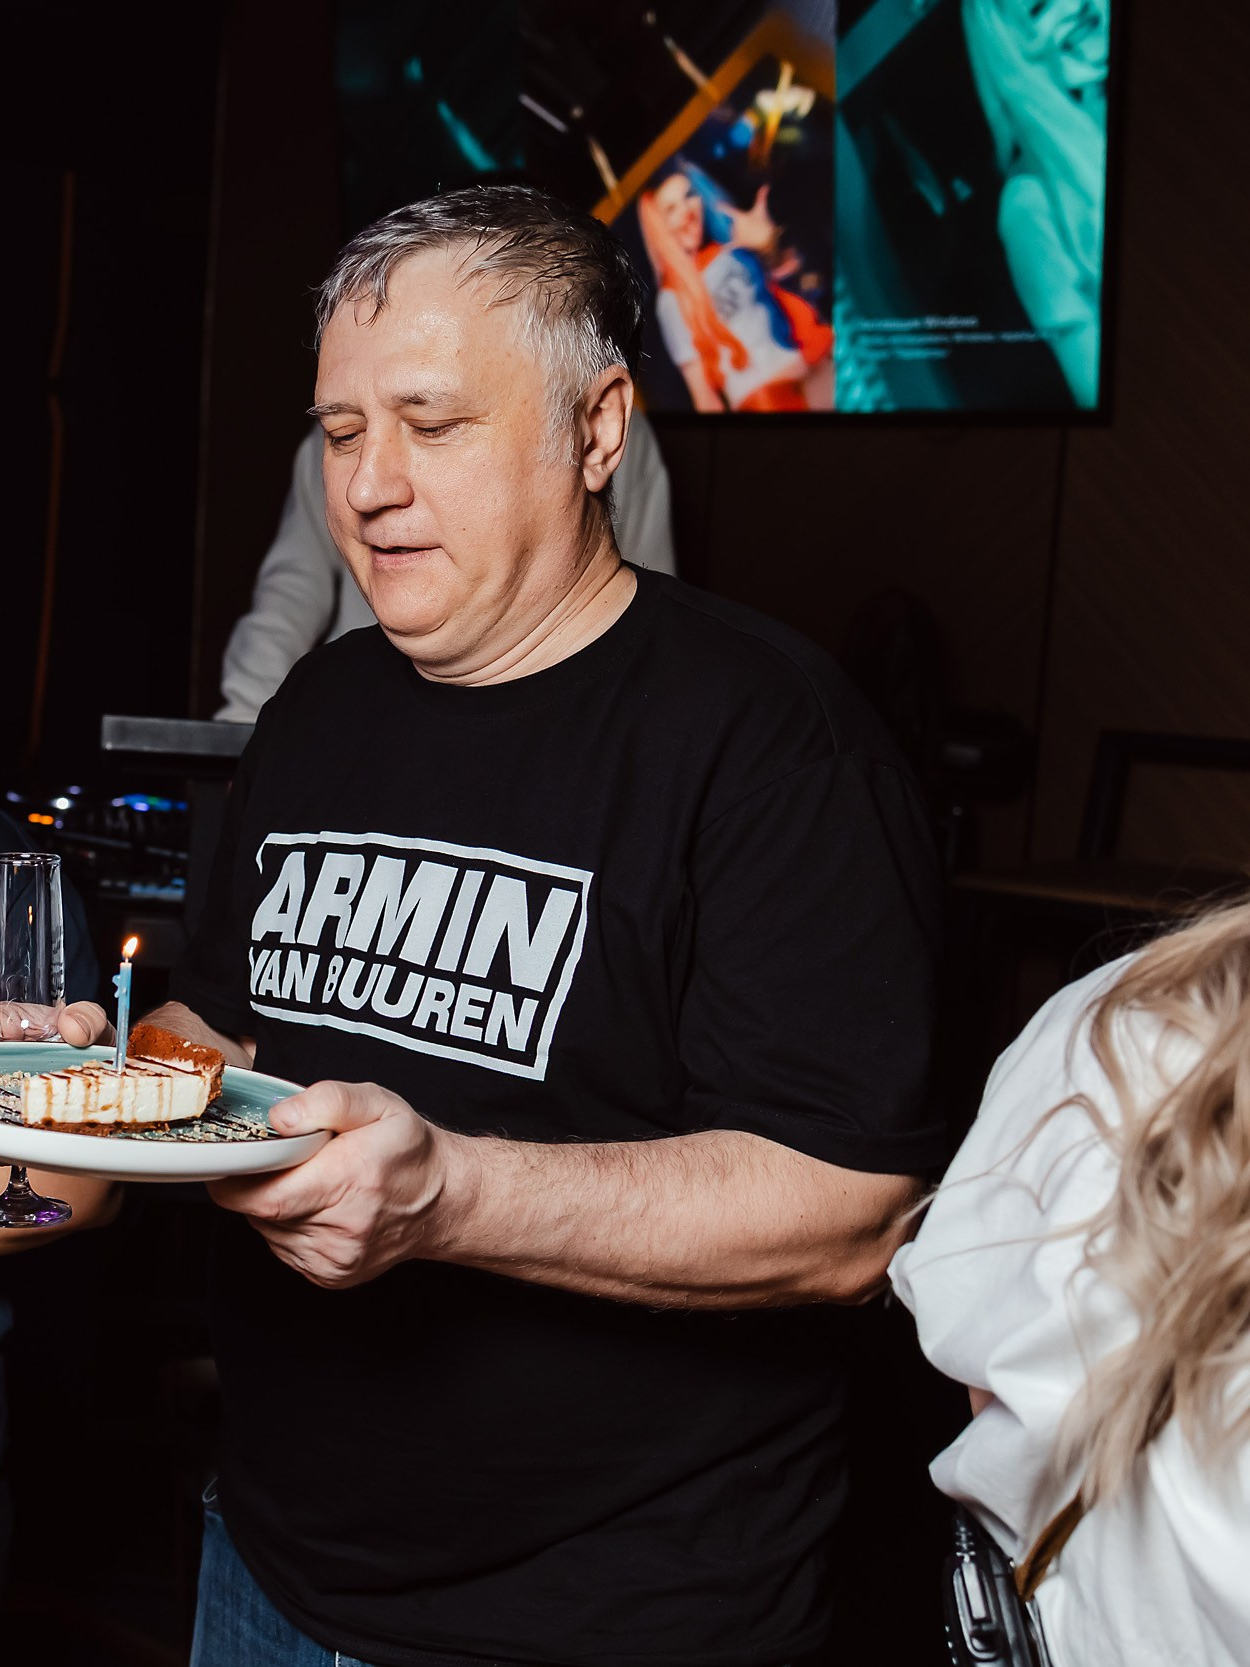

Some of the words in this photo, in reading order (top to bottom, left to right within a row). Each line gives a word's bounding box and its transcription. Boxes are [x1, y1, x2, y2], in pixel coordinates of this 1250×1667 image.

[252, 851, 579, 993] ARMIN
[249, 946, 320, 1004] VAN
[321, 954, 540, 1052] BUUREN
